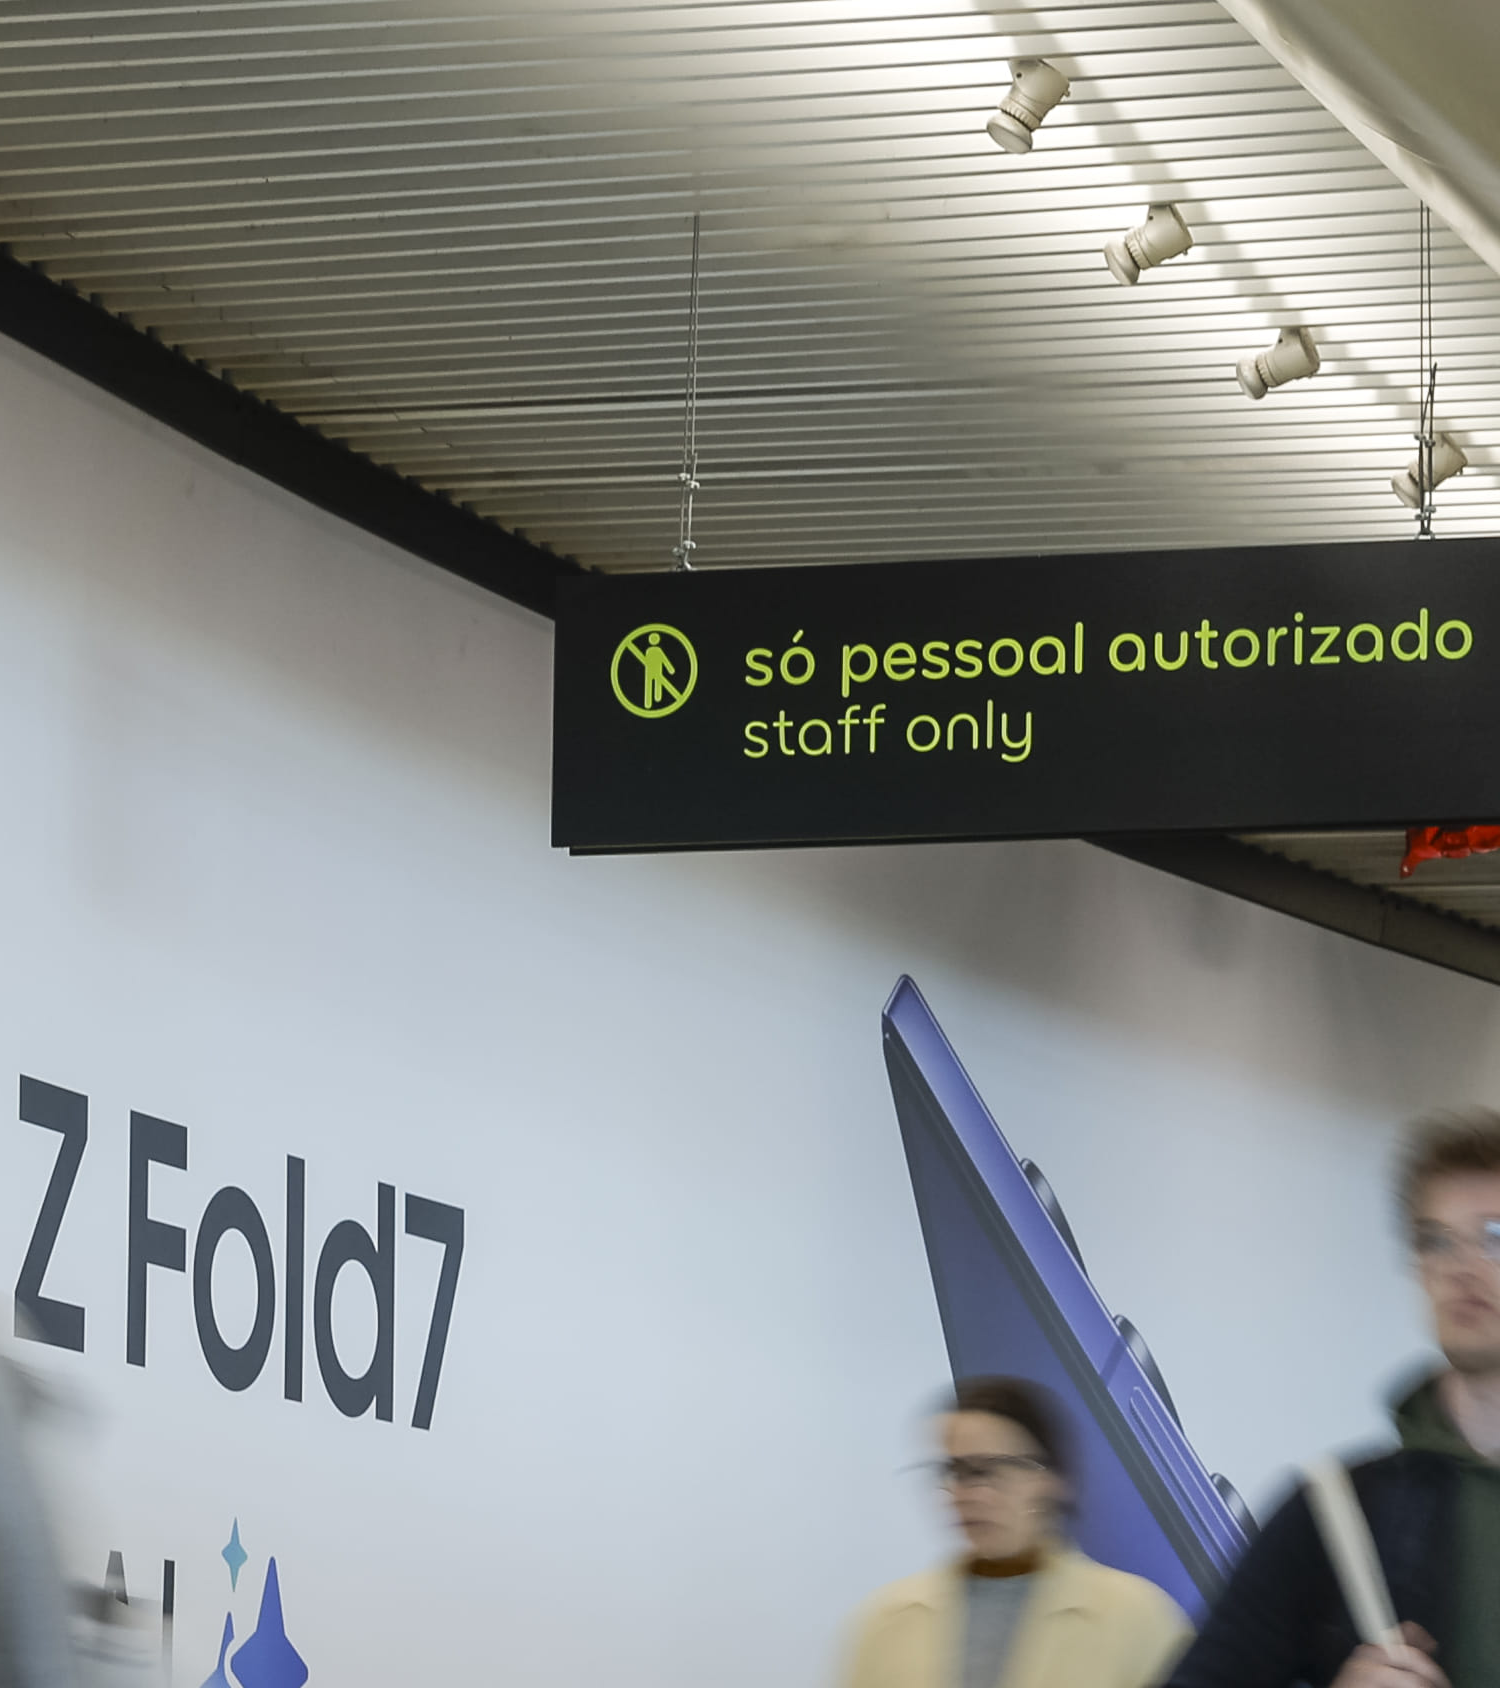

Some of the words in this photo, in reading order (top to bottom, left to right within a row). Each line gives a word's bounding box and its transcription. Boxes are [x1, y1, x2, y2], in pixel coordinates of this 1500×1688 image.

[744, 629, 816, 688] só
[841, 621, 1085, 699] pessoal
[1108, 607, 1474, 673] autorizado
[743, 703, 887, 759] staff
[905, 699, 1033, 763] only
[13, 1072, 89, 1353] Z
[125, 1108, 465, 1432] Fold7
